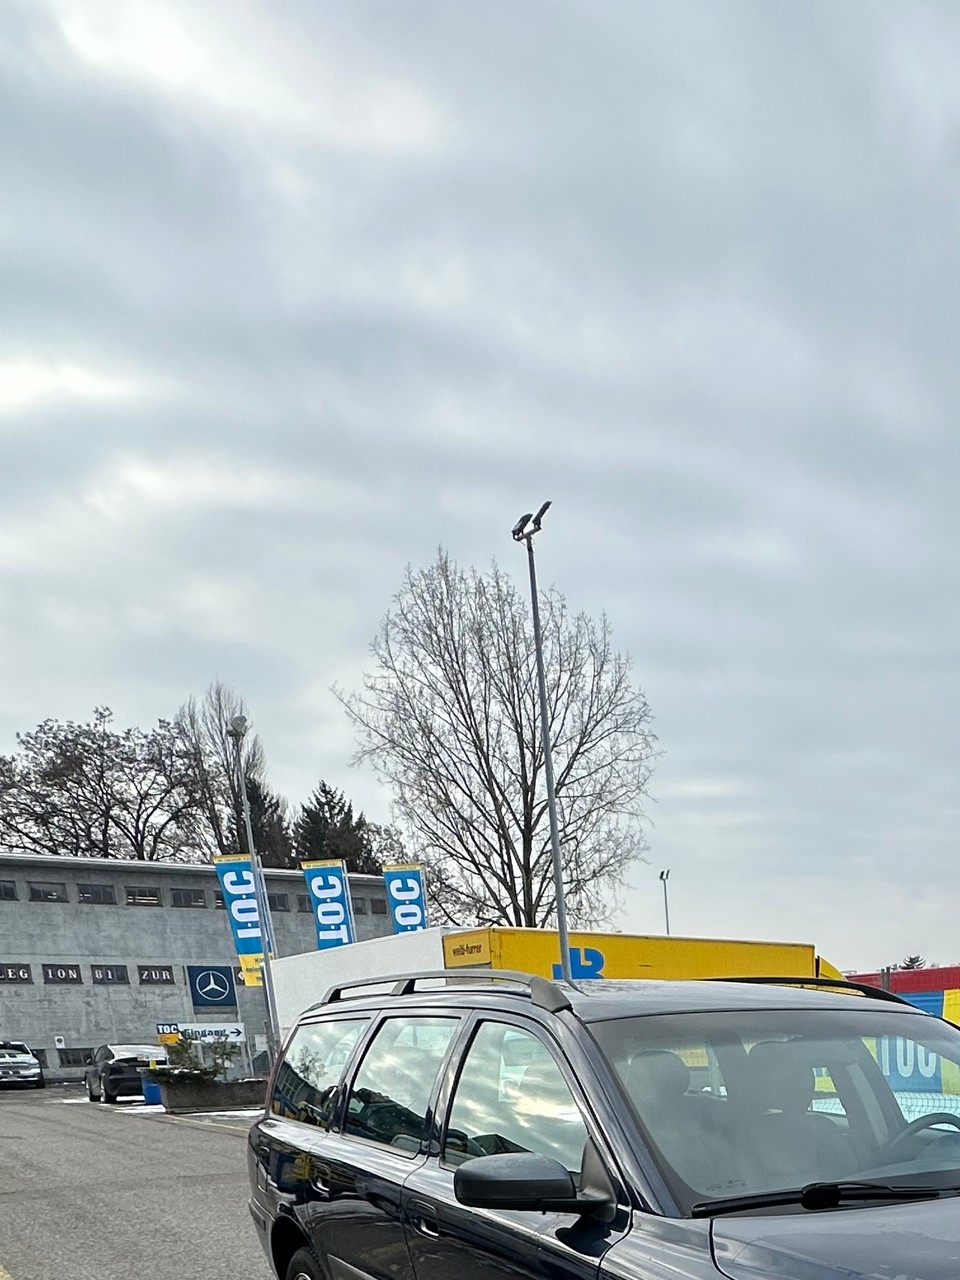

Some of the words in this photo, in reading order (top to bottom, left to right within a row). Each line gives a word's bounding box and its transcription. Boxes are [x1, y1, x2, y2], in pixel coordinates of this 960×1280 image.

[95, 969, 113, 979] 81
[141, 970, 171, 980] ZUR
[157, 1024, 178, 1034] TOC
